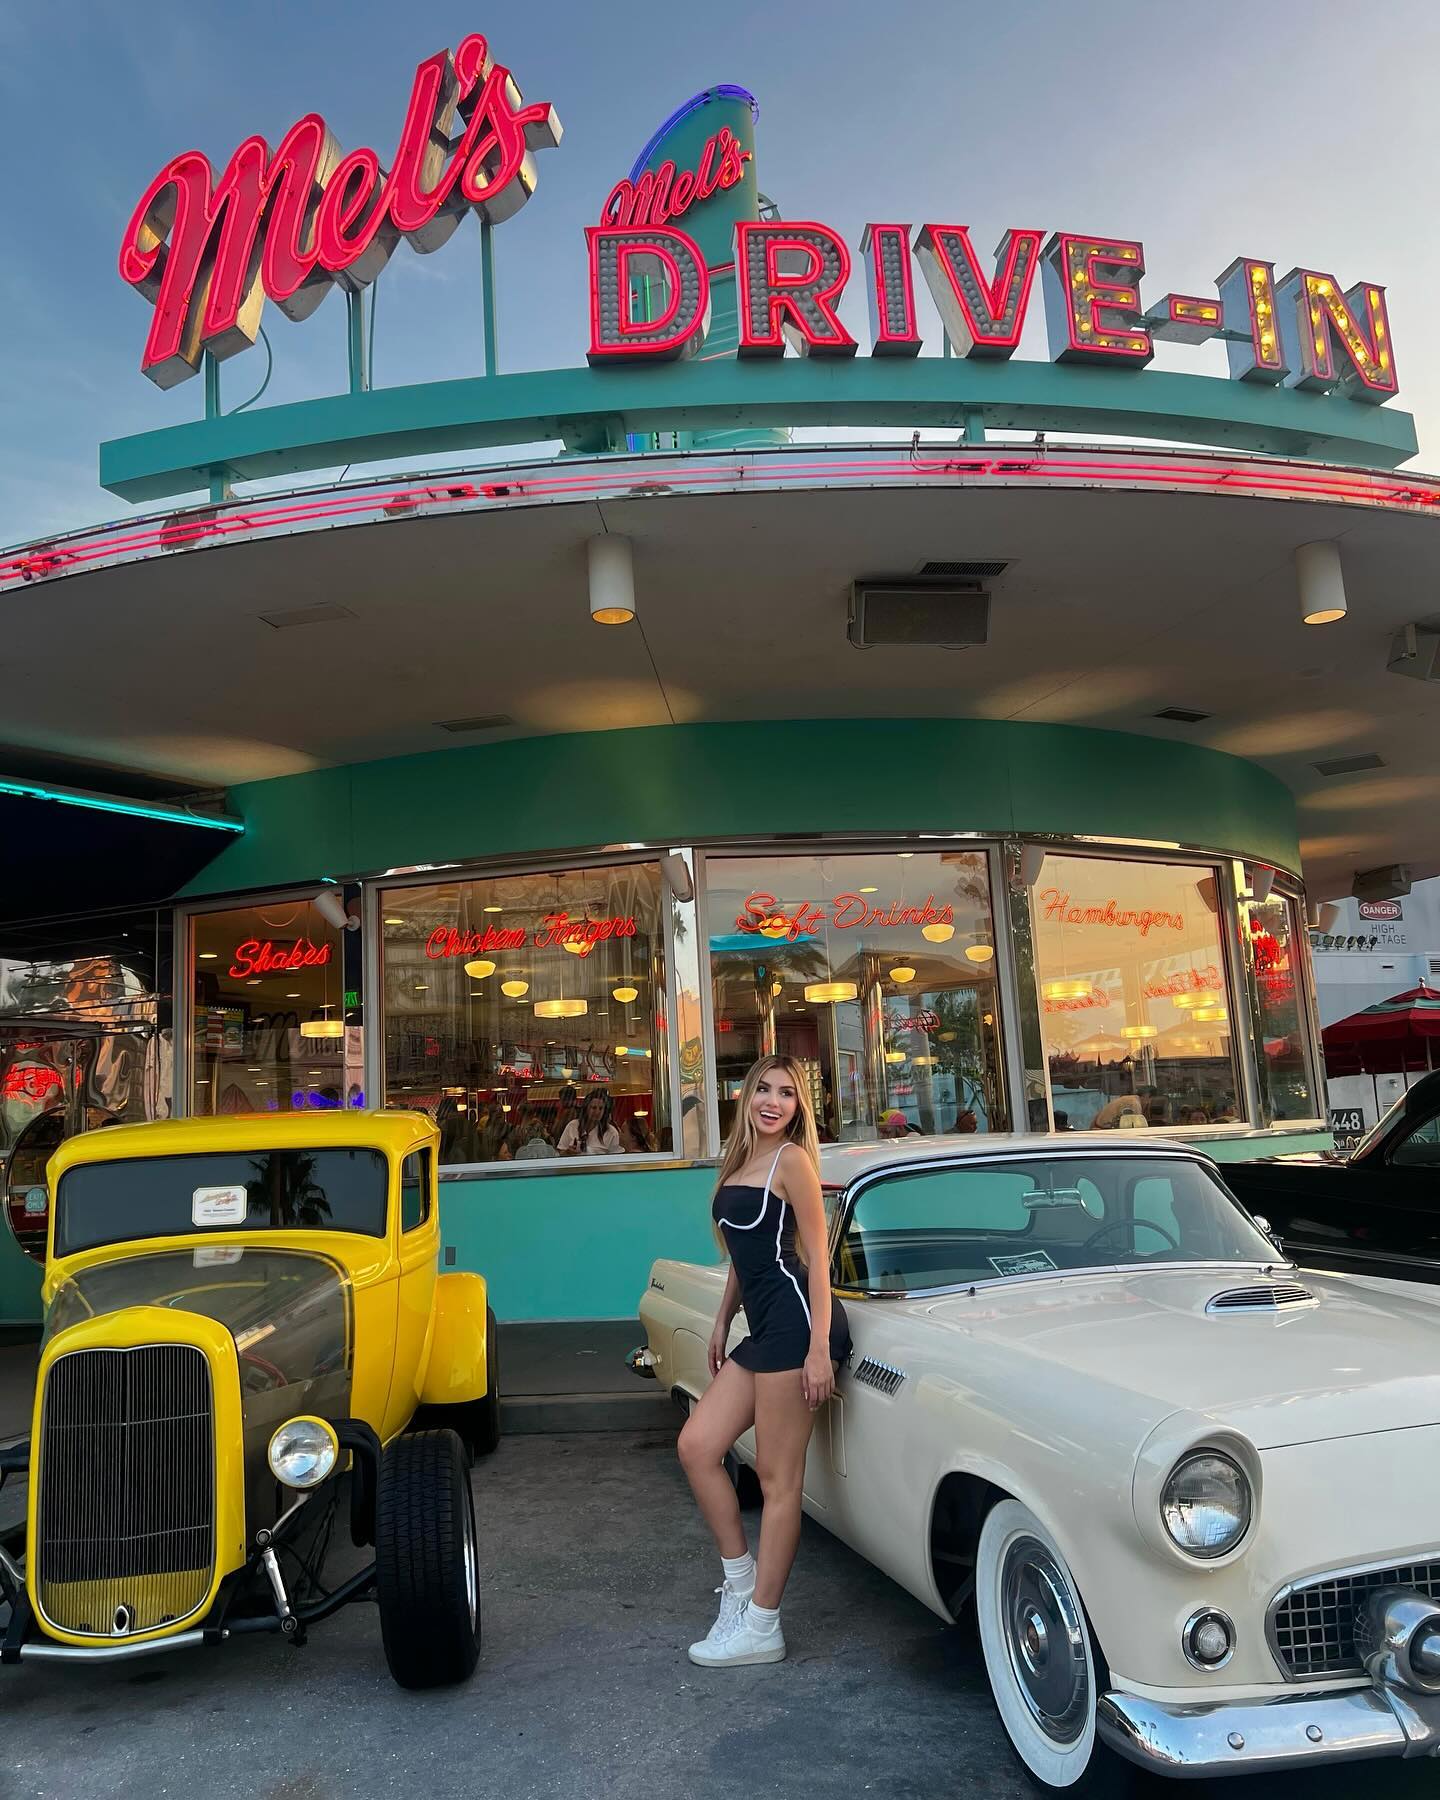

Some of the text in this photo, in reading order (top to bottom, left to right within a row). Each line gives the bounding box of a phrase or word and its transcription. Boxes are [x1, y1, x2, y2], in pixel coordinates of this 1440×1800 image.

[600, 126, 752, 227] Mel's
[119, 33, 557, 382] Mel's
[584, 221, 1399, 400] DRIVE-IN
[735, 893, 954, 942] Soft Drinks
[1039, 888, 1184, 937] Hamburgers
[1362, 906, 1398, 916] DANGER
[1371, 924, 1395, 934] HIGH
[229, 937, 330, 978] Shakes
[425, 912, 637, 960] Chicken Fingers
